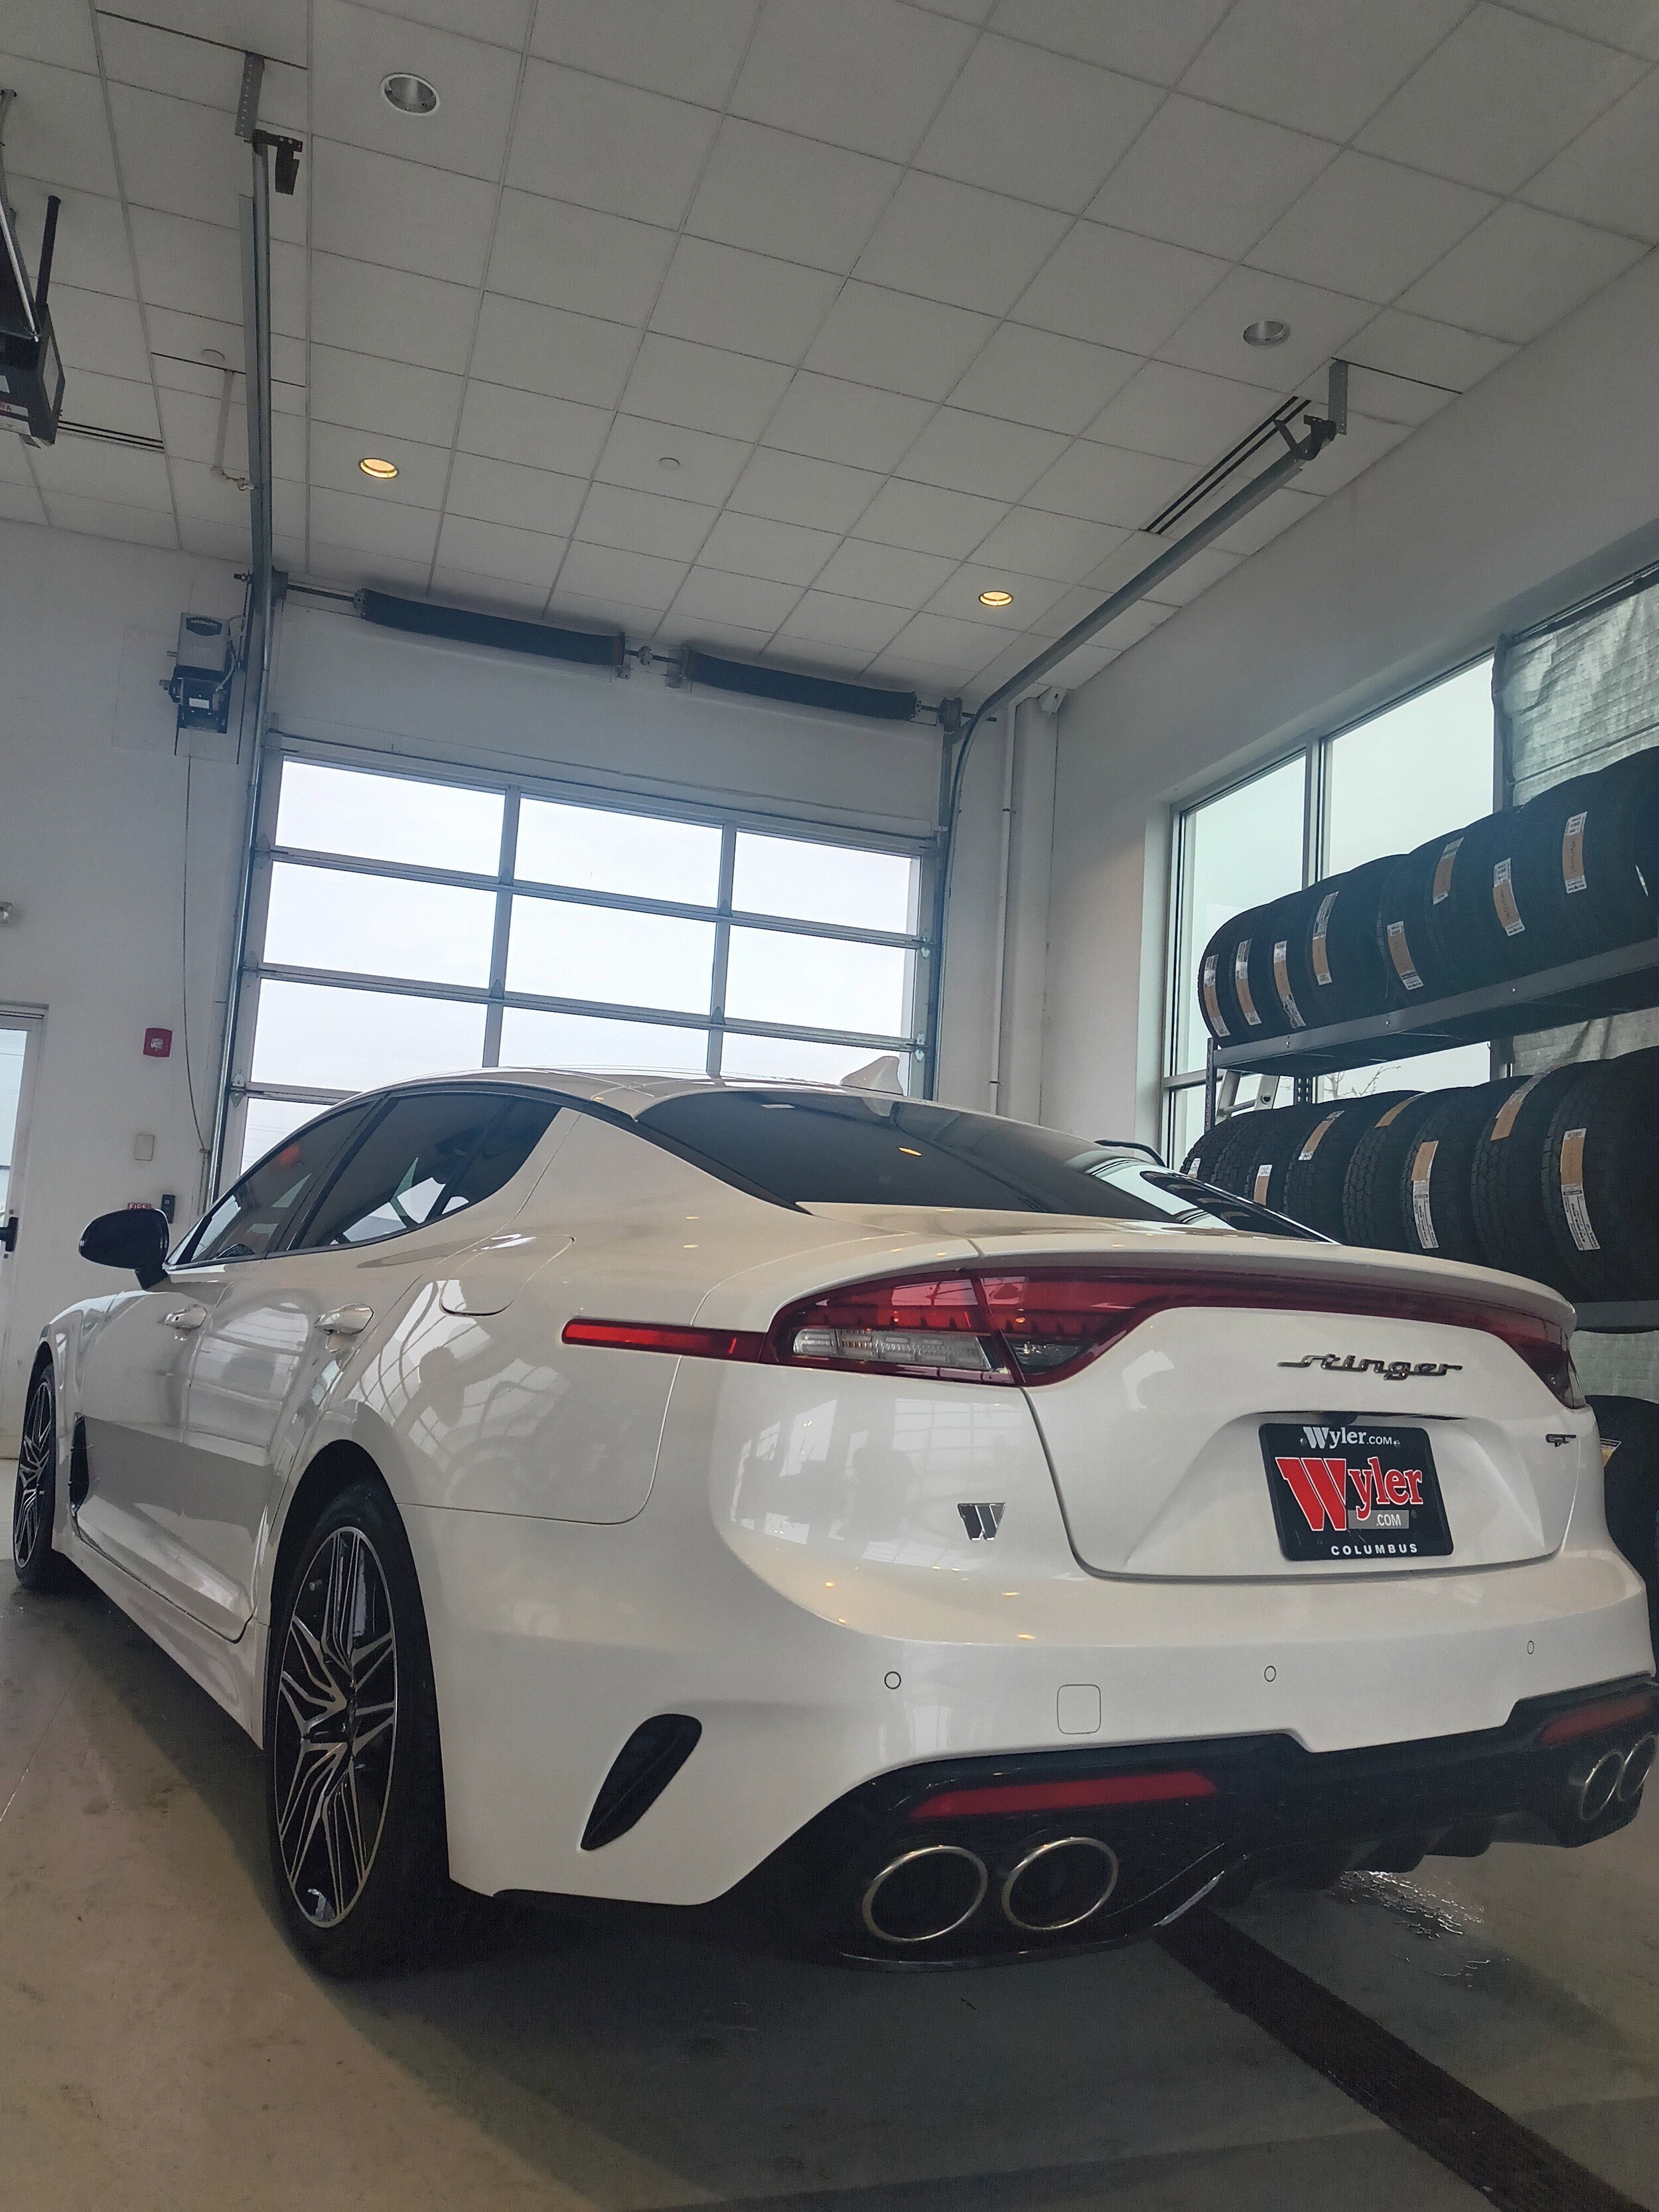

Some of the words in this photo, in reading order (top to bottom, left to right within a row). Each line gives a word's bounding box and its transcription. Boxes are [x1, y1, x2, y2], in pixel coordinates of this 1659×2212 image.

[1275, 1456, 1423, 1531] Wyler
[958, 1503, 1006, 1541] W
[1376, 1514, 1402, 1526] .COM
[1331, 1543, 1417, 1556] COLUMBUS
